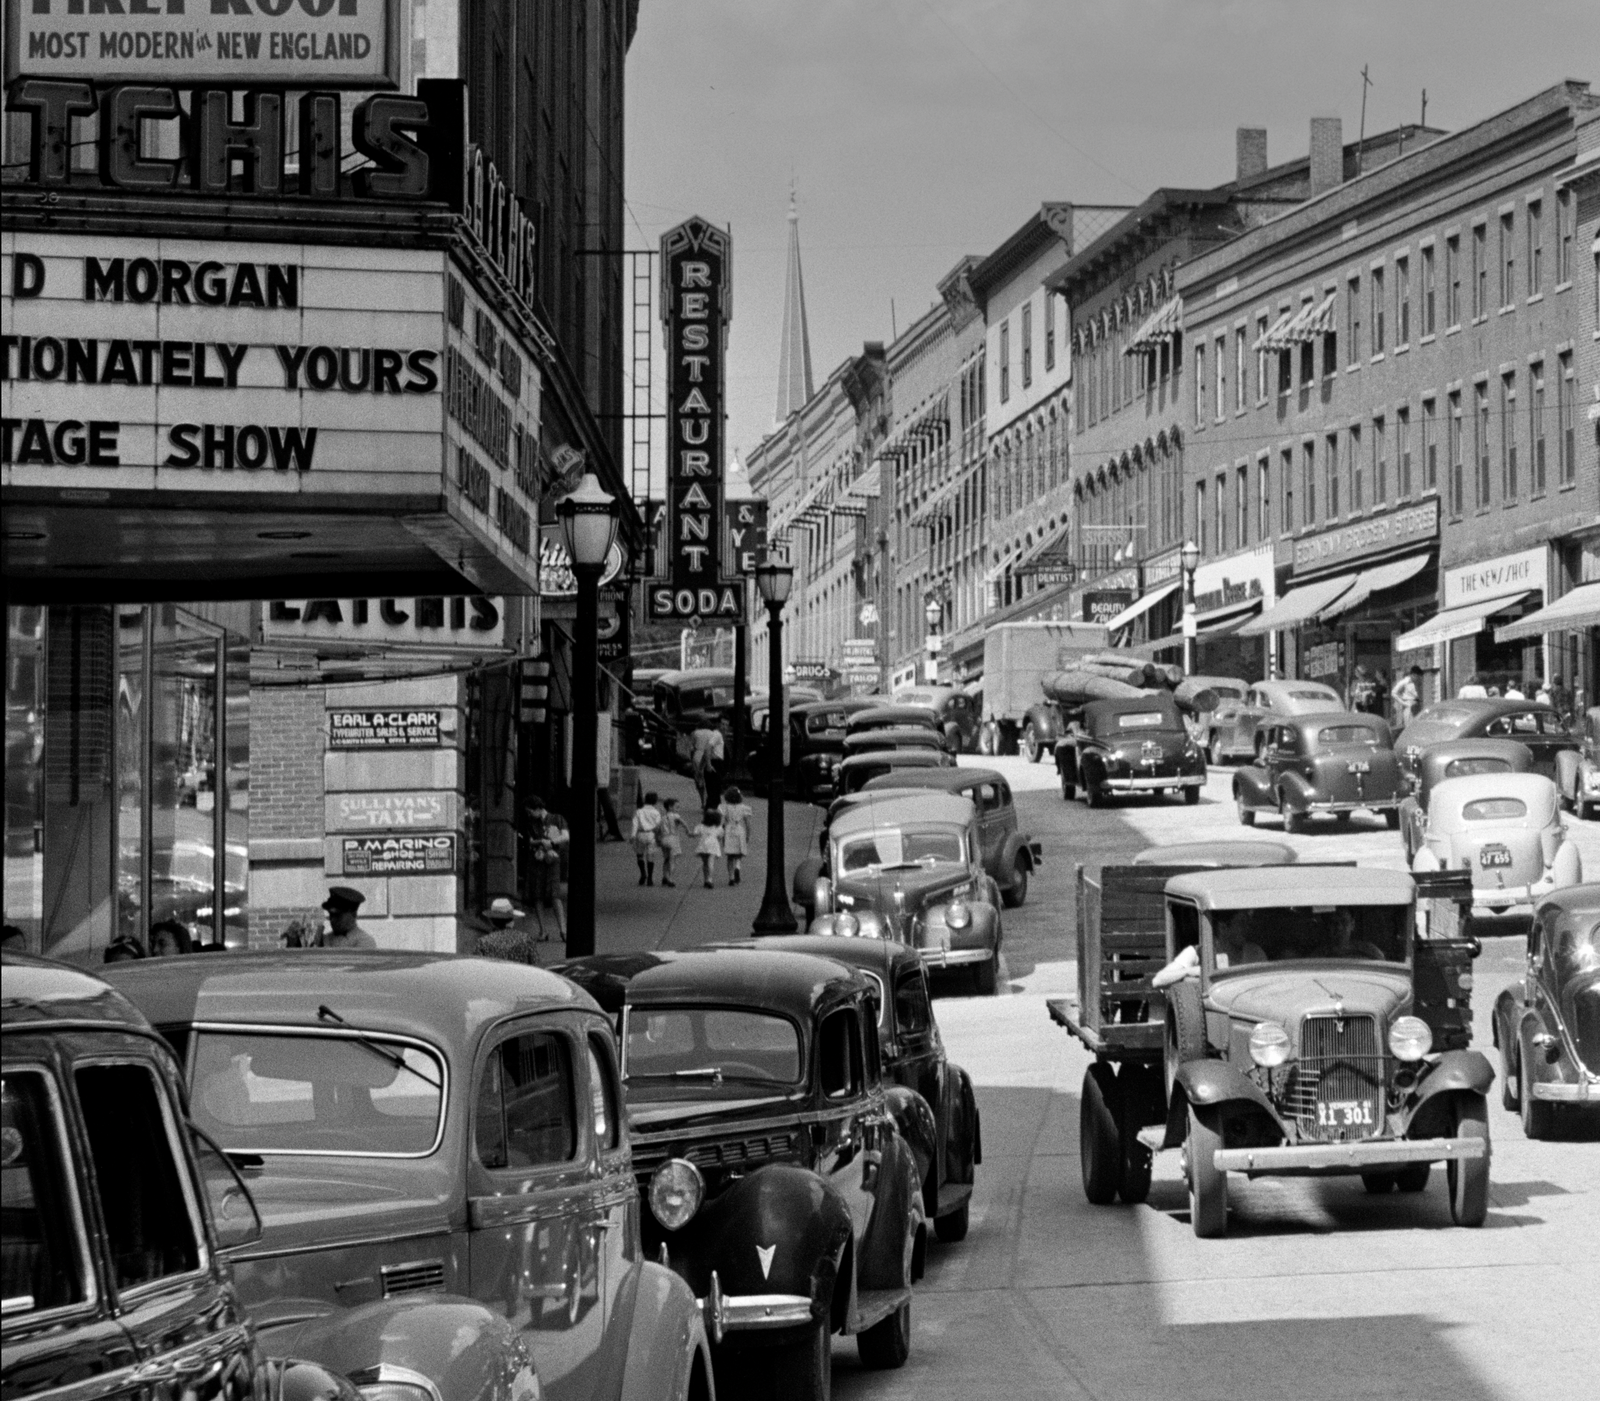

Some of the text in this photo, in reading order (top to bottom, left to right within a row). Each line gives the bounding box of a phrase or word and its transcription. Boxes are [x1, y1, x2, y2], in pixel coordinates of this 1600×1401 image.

[28, 31, 90, 60] MOST
[99, 32, 194, 60] MODERN
[217, 32, 264, 60] NEW
[269, 32, 371, 61] ENGLAND
[20, 80, 430, 195] TCHIS
[84, 255, 300, 309] MORGAN
[275, 344, 439, 395] YOURS
[679, 260, 713, 574] RESTAURANT
[164, 421, 318, 473] SHOW
[1394, 505, 1437, 537] STORES
[1037, 573, 1074, 583] DENTIST
[1460, 560, 1531, 594] THE NEWS SHOP
[653, 587, 740, 616] SODA
[1090, 602, 1126, 613] BEAUTY
[795, 665, 831, 677] DRUGS
[332, 713, 371, 727] EARL
[388, 712, 438, 726] CLARK
[332, 727, 375, 738] TYPEWRITER
[376, 727, 398, 738] SALES
[406, 726, 438, 737] SERVICE
[366, 809, 415, 826] TAXI
[344, 837, 451, 851] P. MARINO
[382, 849, 415, 861] SHOE
[371, 860, 425, 871] REPAIRING
[1342, 1107, 1373, 1126] 301
